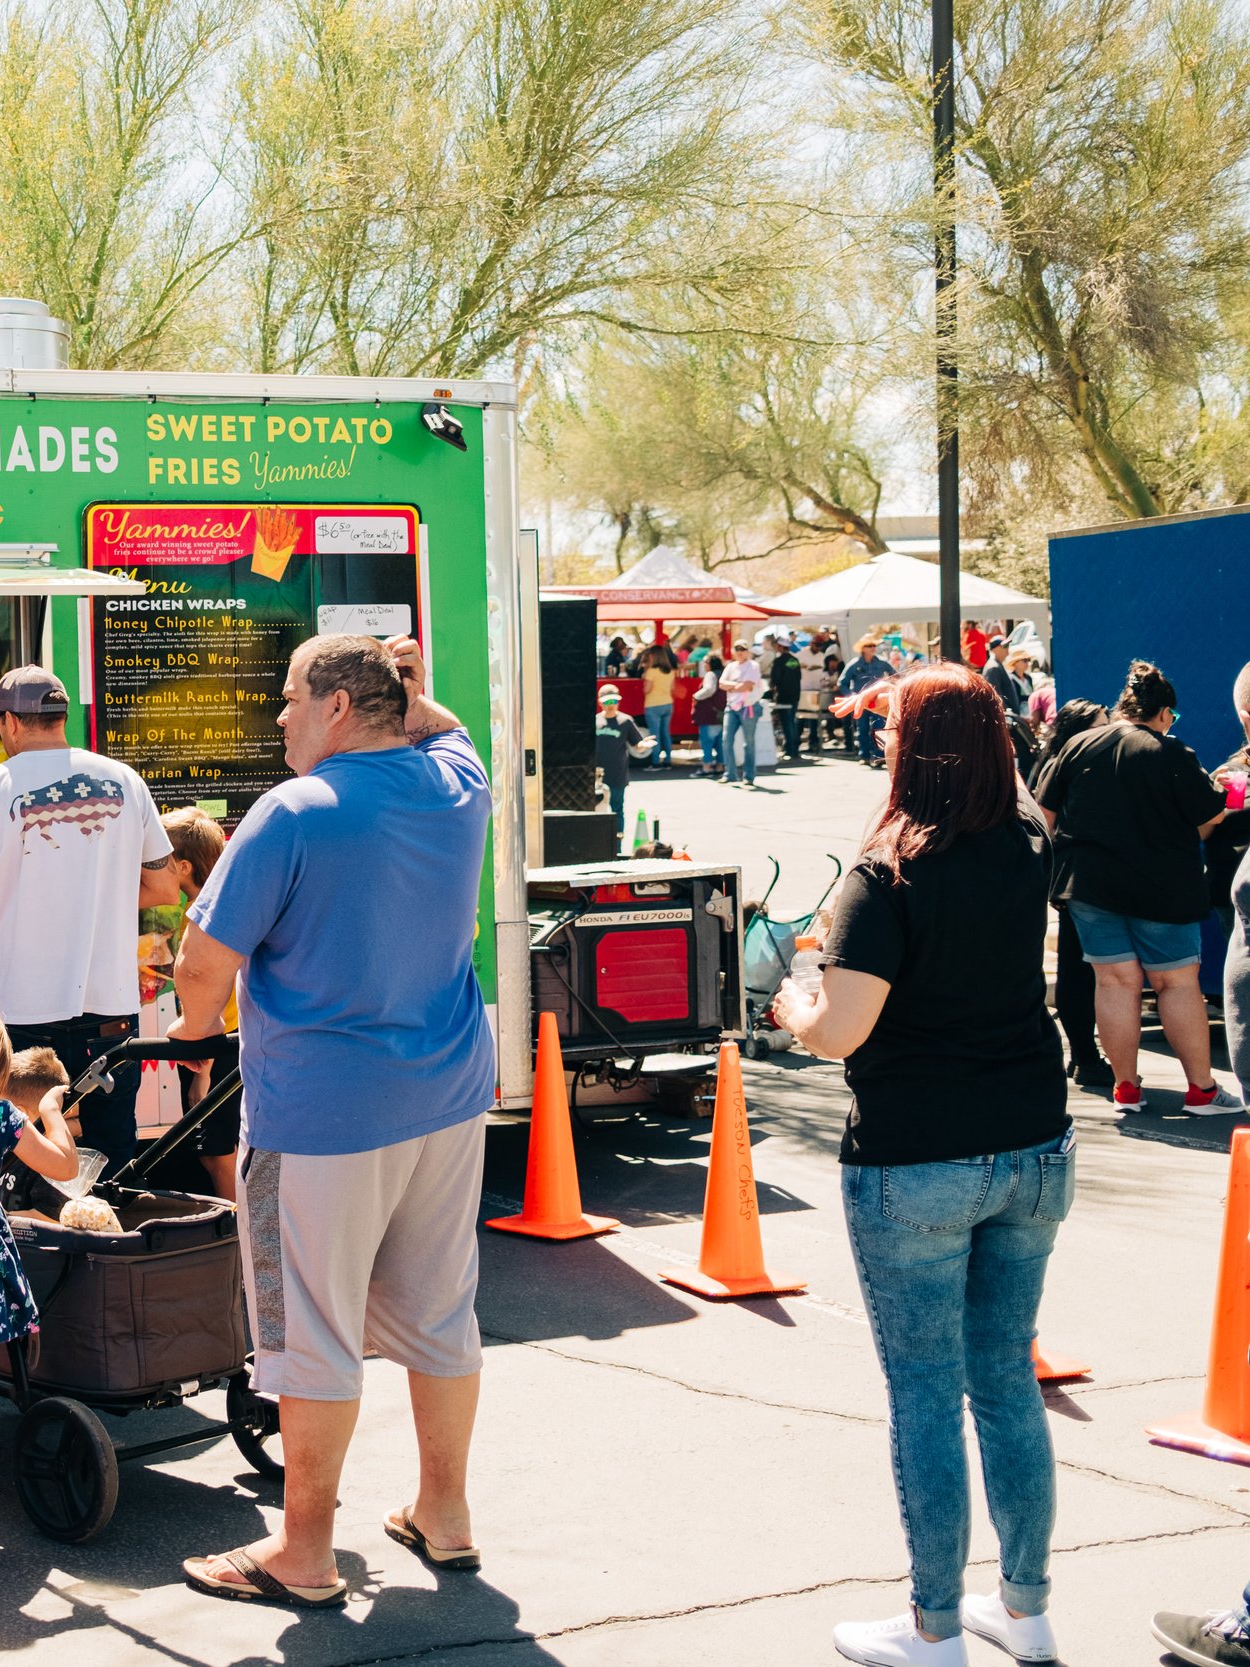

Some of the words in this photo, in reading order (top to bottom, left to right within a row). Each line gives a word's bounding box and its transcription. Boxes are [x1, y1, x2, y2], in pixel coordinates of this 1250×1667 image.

[147, 414, 255, 441] SWEET
[268, 416, 392, 444] POTATO
[149, 458, 240, 484] FRIES
[249, 446, 355, 491] Yammies!
[100, 511, 251, 544] Yammies!
[162, 541, 192, 550] winning
[214, 541, 239, 549] potato
[601, 590, 689, 601] CONSERVANCY
[106, 600, 183, 611] CHICKEN
[187, 599, 246, 610] WRAPS
[104, 616, 148, 632] Honey
[155, 616, 214, 631] Chipotle
[104, 654, 160, 670] Smokey
[168, 654, 200, 666] BBQ
[105, 692, 179, 704] Buttermilk
[187, 690, 228, 702] Ranch
[106, 730, 139, 744] Wrap
[147, 729, 166, 742] Of
[173, 728, 196, 740] The
[142, 766, 182, 778] tarian
[732, 1089, 745, 1155] TUCSON
